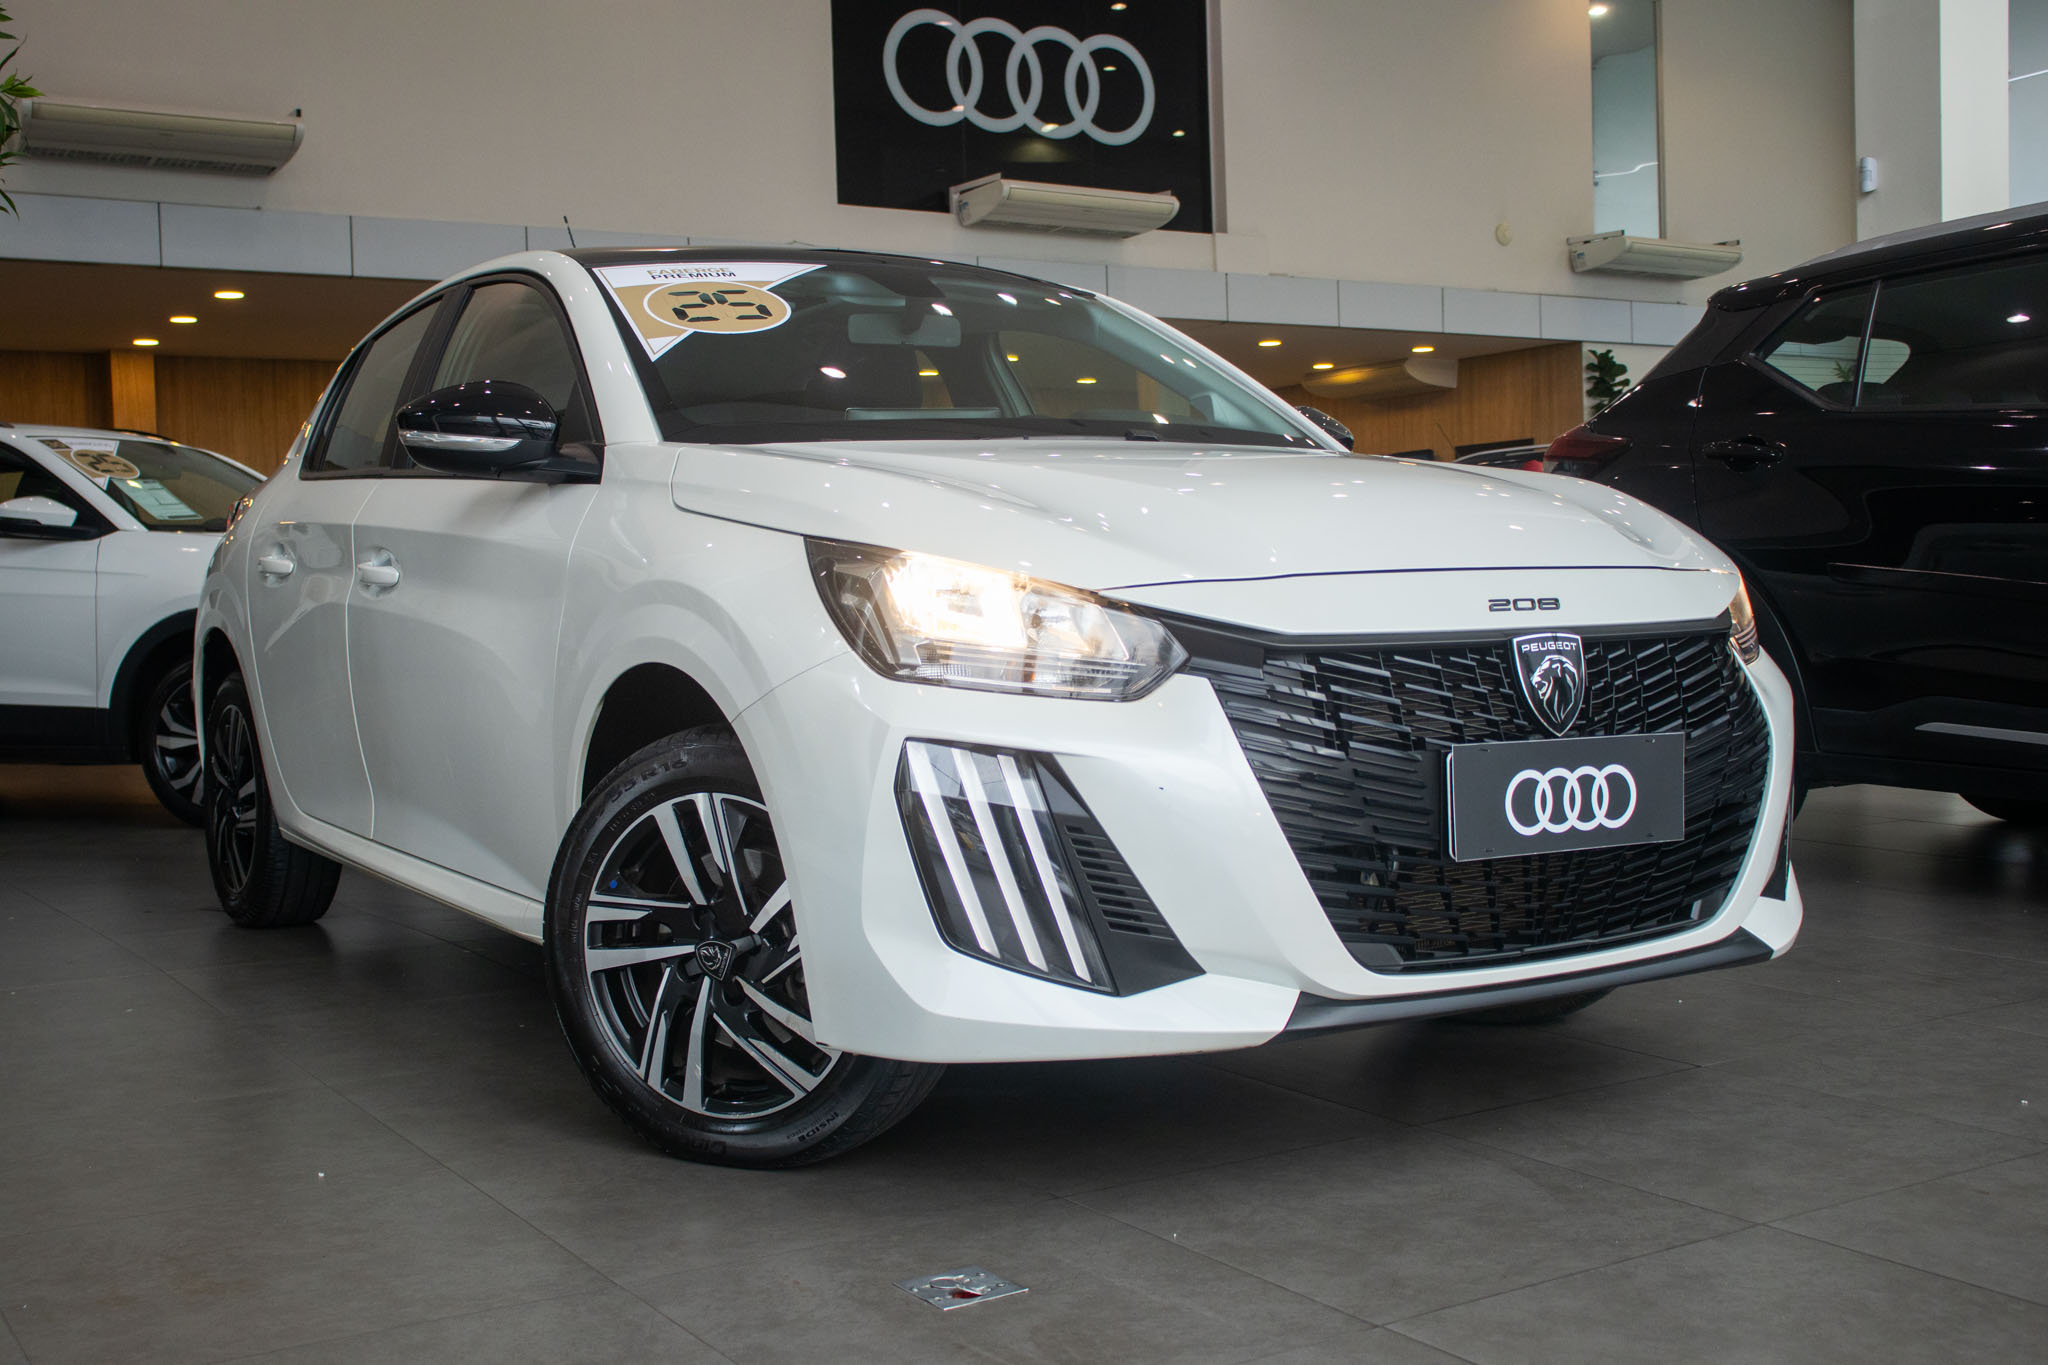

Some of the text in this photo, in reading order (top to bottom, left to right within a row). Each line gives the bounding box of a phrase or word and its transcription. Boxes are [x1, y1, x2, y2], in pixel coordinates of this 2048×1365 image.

[651, 272, 736, 280] PREMIUM
[1488, 598, 1560, 612] 208
[1521, 641, 1577, 653] PEUGEOT
